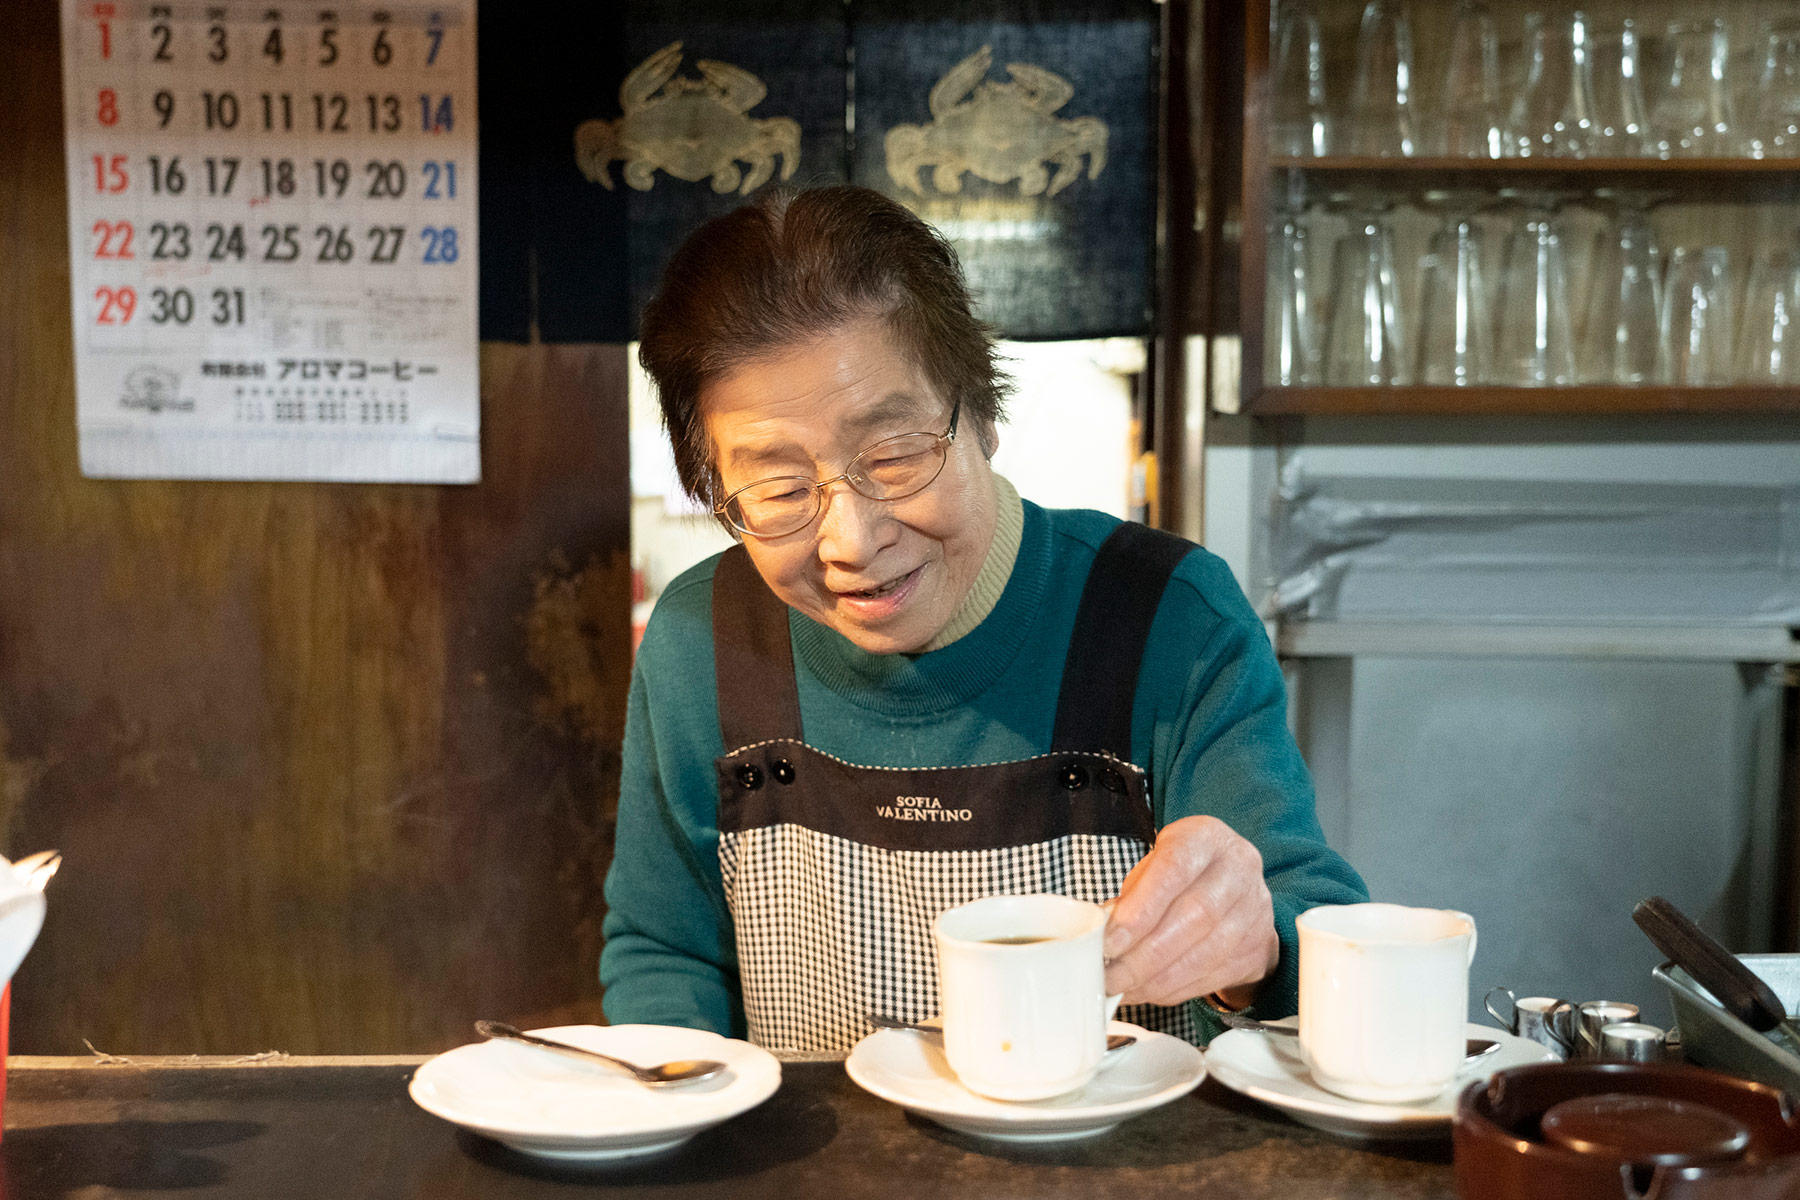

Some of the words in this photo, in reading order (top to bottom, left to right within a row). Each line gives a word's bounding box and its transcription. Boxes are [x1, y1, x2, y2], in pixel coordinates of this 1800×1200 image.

[98, 23, 112, 59] 1
[152, 23, 174, 63] 2
[209, 24, 229, 64] 3
[263, 27, 285, 65] 4
[319, 26, 340, 67] 5
[372, 27, 393, 67] 6
[425, 28, 445, 68] 7
[98, 89, 119, 126] 8
[153, 89, 175, 128] 9
[202, 91, 240, 130] 10
[261, 92, 292, 130] 11
[312, 91, 349, 132] 12
[365, 92, 402, 133] 13
[420, 93, 455, 133] 14
[92, 153, 129, 193] 15
[148, 154, 186, 194] 16
[203, 155, 241, 195] 17
[260, 157, 296, 197] 18
[313, 157, 351, 197] 19
[365, 158, 406, 198] 20
[422, 158, 456, 198] 21
[93, 220, 135, 259] 22
[150, 222, 191, 260] 23
[206, 224, 246, 260] 24
[262, 225, 300, 263] 25
[315, 225, 354, 263] 26
[367, 226, 406, 263] 27
[421, 227, 458, 263] 28
[95, 286, 137, 324] 29
[151, 288, 194, 325] 30
[212, 288, 244, 325] 31
[277, 359, 438, 380] アロマコーヒー
[876, 806, 972, 821] VALENTINO
[896, 796, 941, 809] SOFIA
